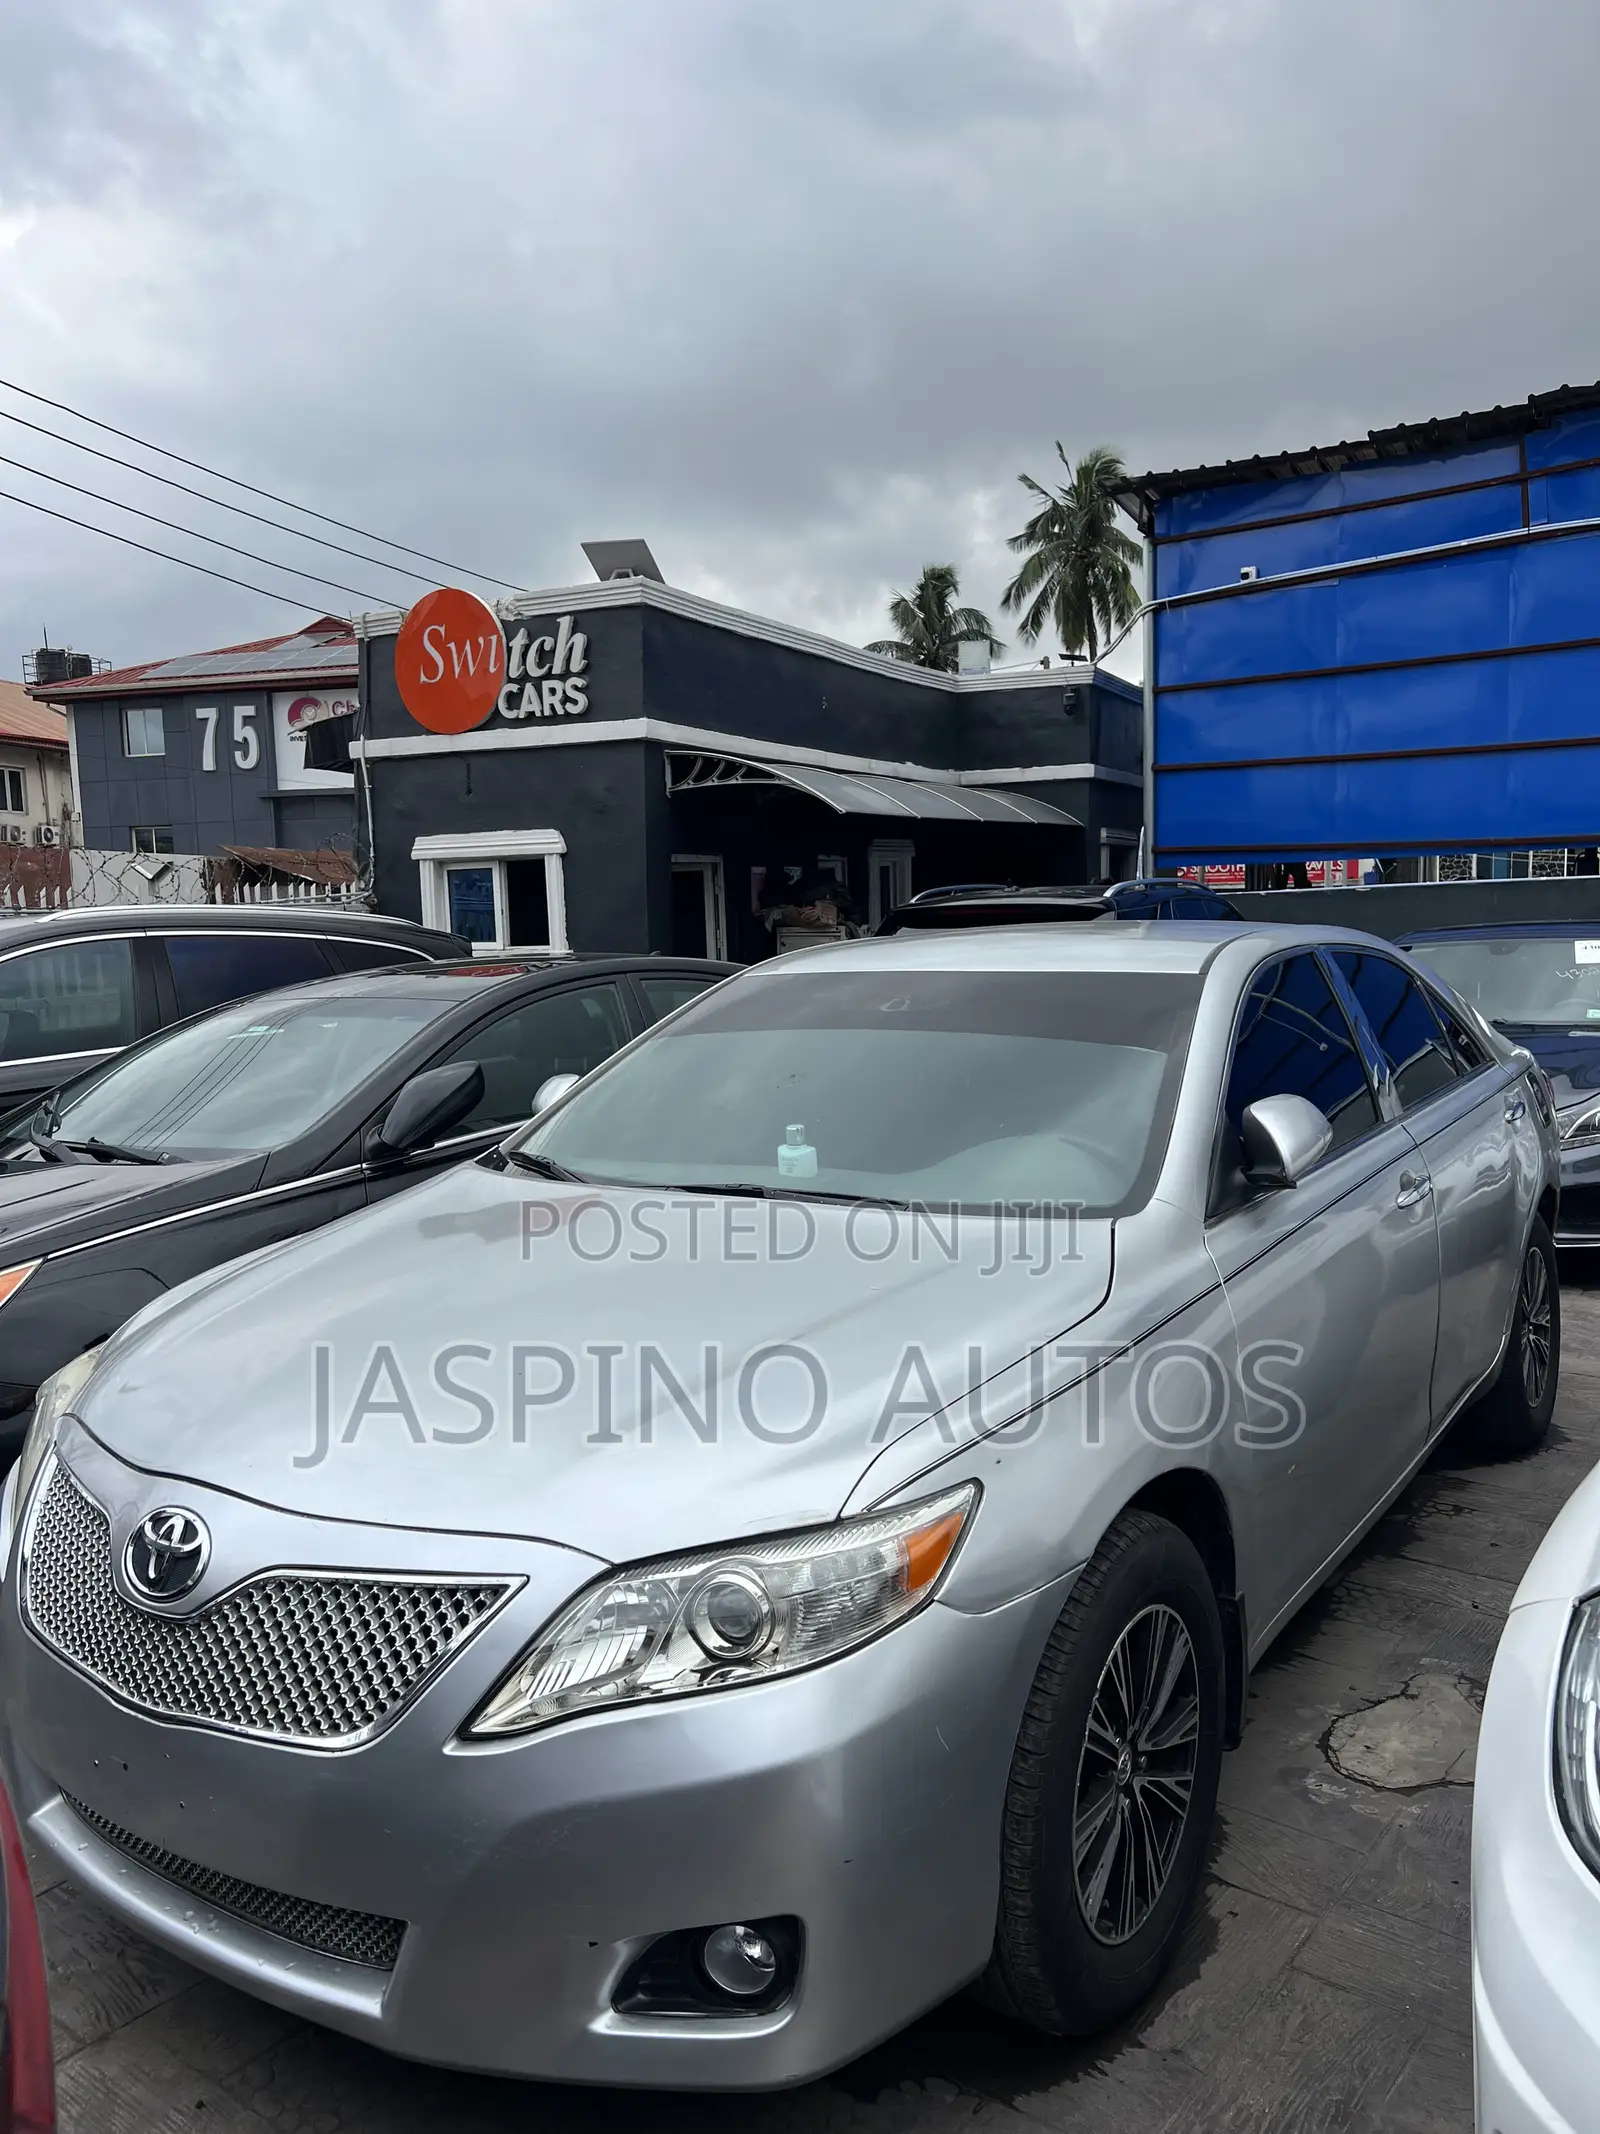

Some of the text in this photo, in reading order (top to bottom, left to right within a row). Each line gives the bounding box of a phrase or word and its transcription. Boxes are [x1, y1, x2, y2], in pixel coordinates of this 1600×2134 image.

[420, 614, 588, 684] Switch
[497, 676, 589, 719] CARS
[195, 705, 260, 772] 75
